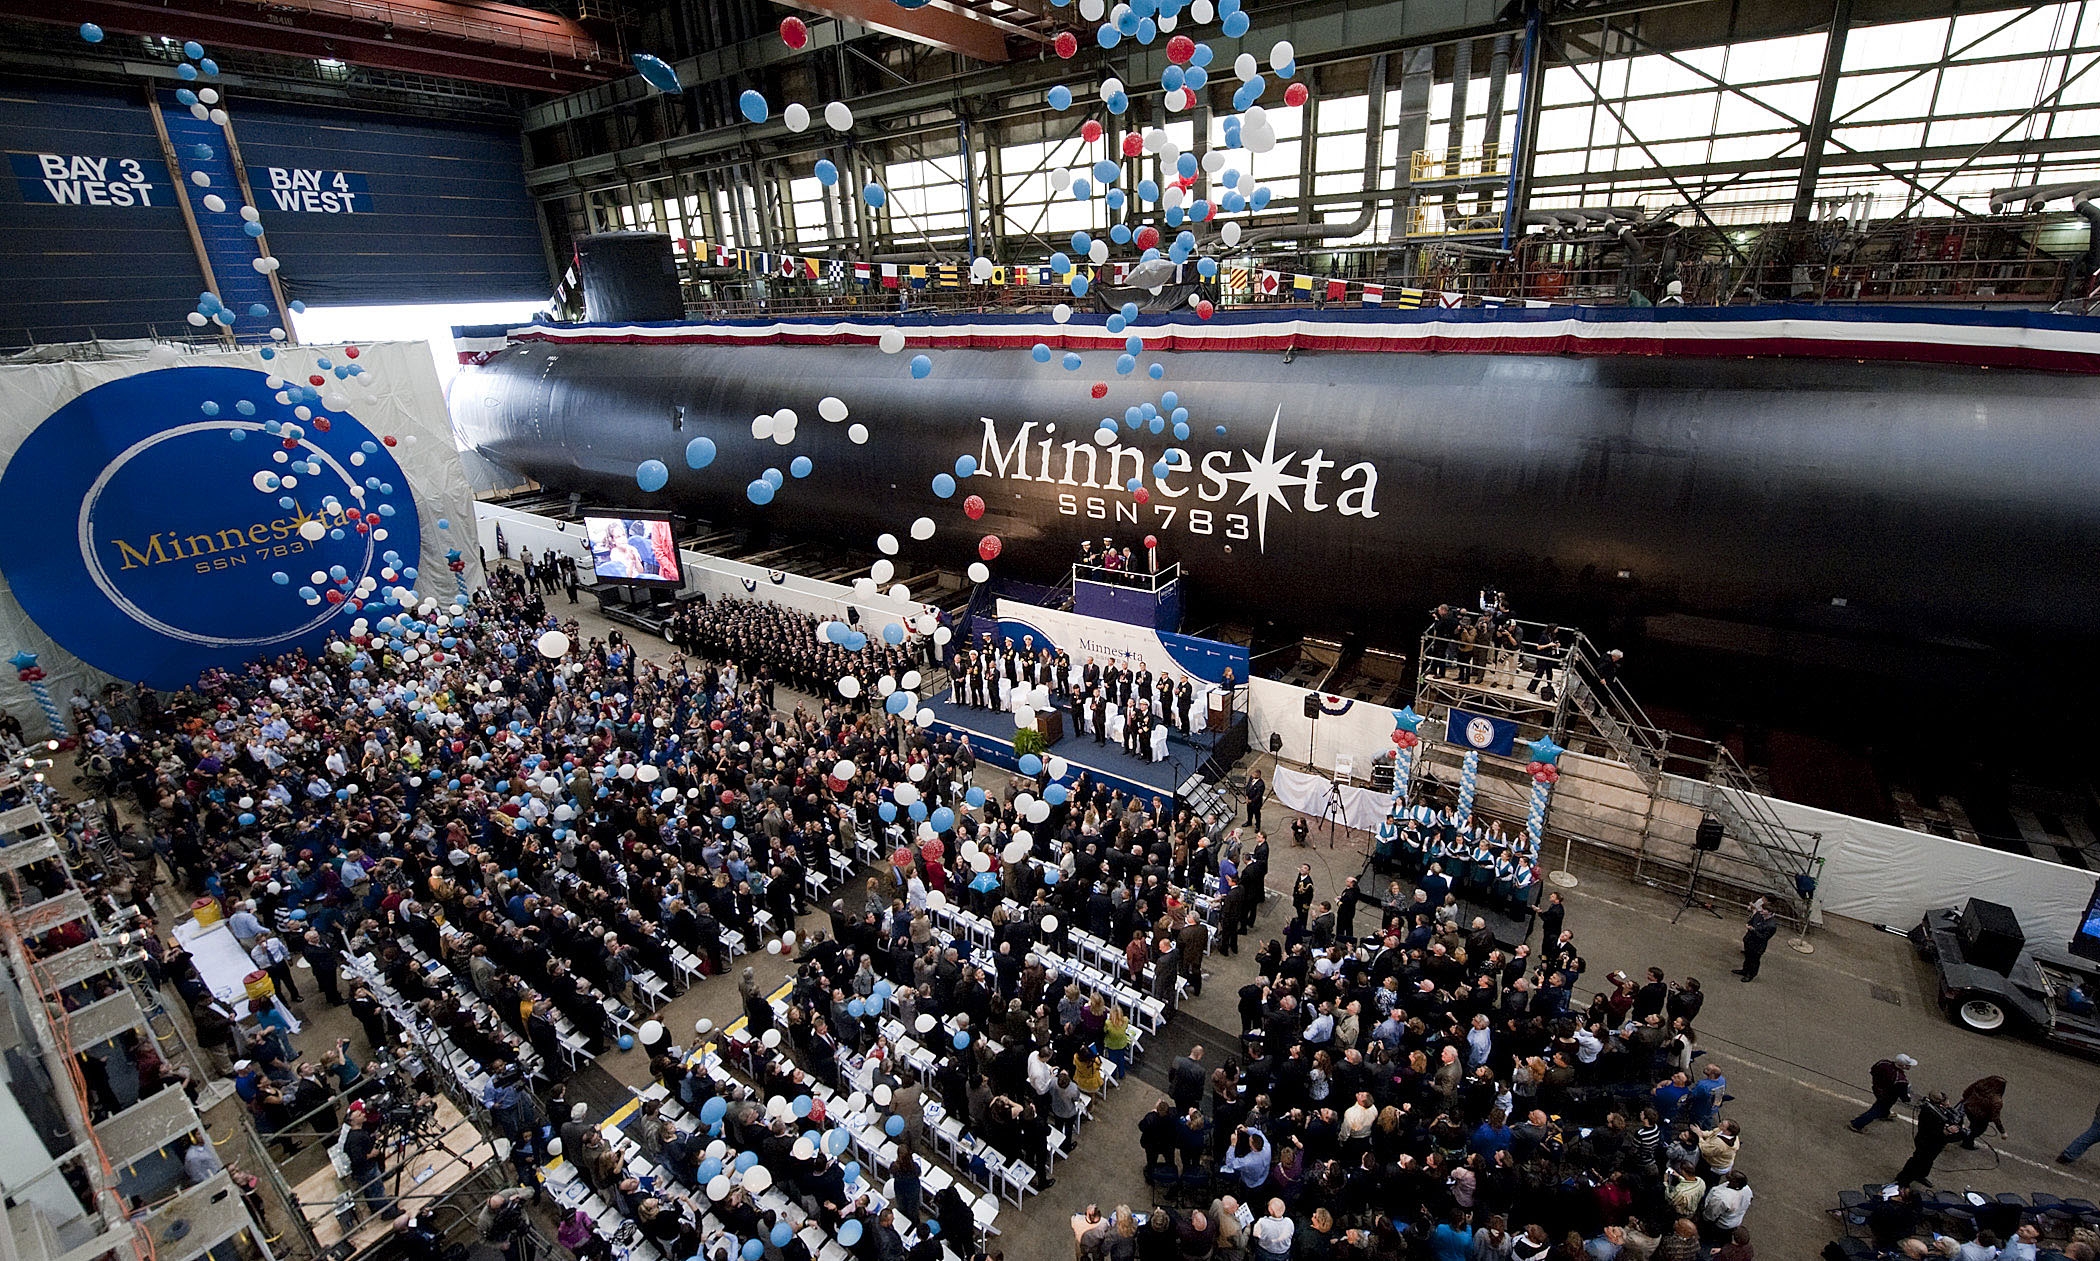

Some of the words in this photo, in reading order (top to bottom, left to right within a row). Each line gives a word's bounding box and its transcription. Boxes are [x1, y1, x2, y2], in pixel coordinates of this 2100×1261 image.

[38, 154, 108, 181] BAY
[119, 158, 145, 183] 3
[268, 167, 322, 191] BAY
[332, 172, 349, 192] 4
[43, 179, 153, 207] WEST
[270, 189, 355, 213] WEST
[1058, 493, 1138, 525] SSN
[1154, 504, 1250, 540] 783
[195, 553, 247, 574] SSN
[256, 541, 305, 561] 783
